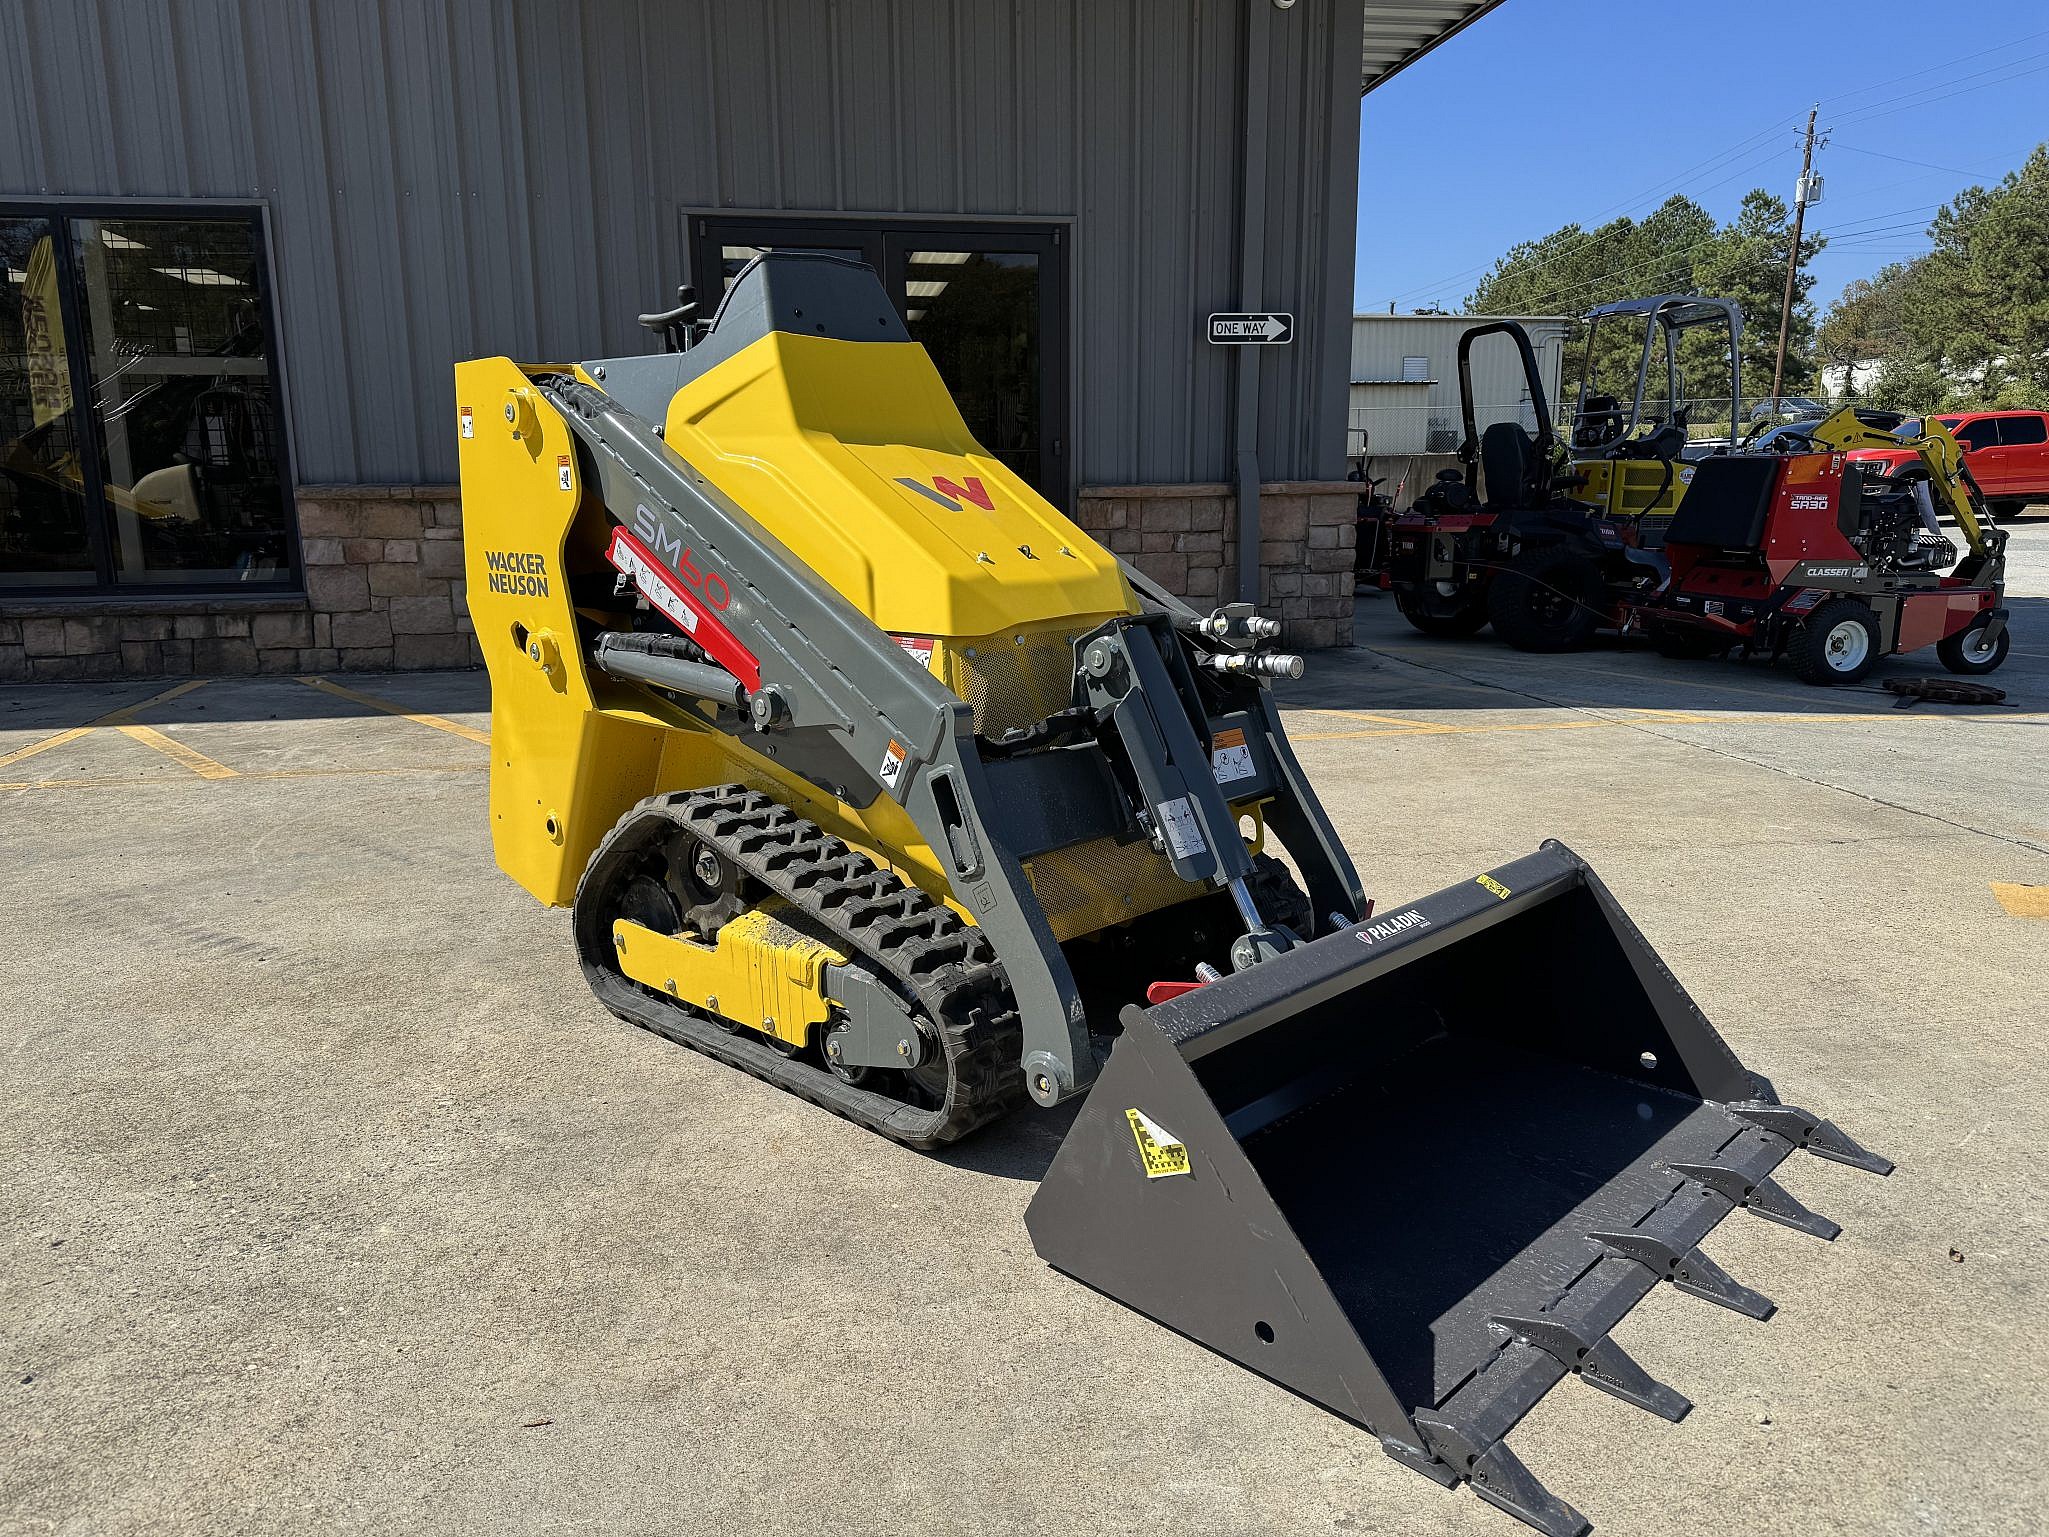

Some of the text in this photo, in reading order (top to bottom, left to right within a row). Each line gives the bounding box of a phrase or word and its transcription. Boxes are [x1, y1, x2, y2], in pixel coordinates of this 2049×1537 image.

[1216, 322, 1266, 334] ONE WAY
[1790, 501, 1829, 510] SA30
[485, 551, 547, 576] WACKER
[633, 502, 730, 611] SM60
[488, 572, 549, 597] NEUSON
[1367, 909, 1426, 940] PALADIN
